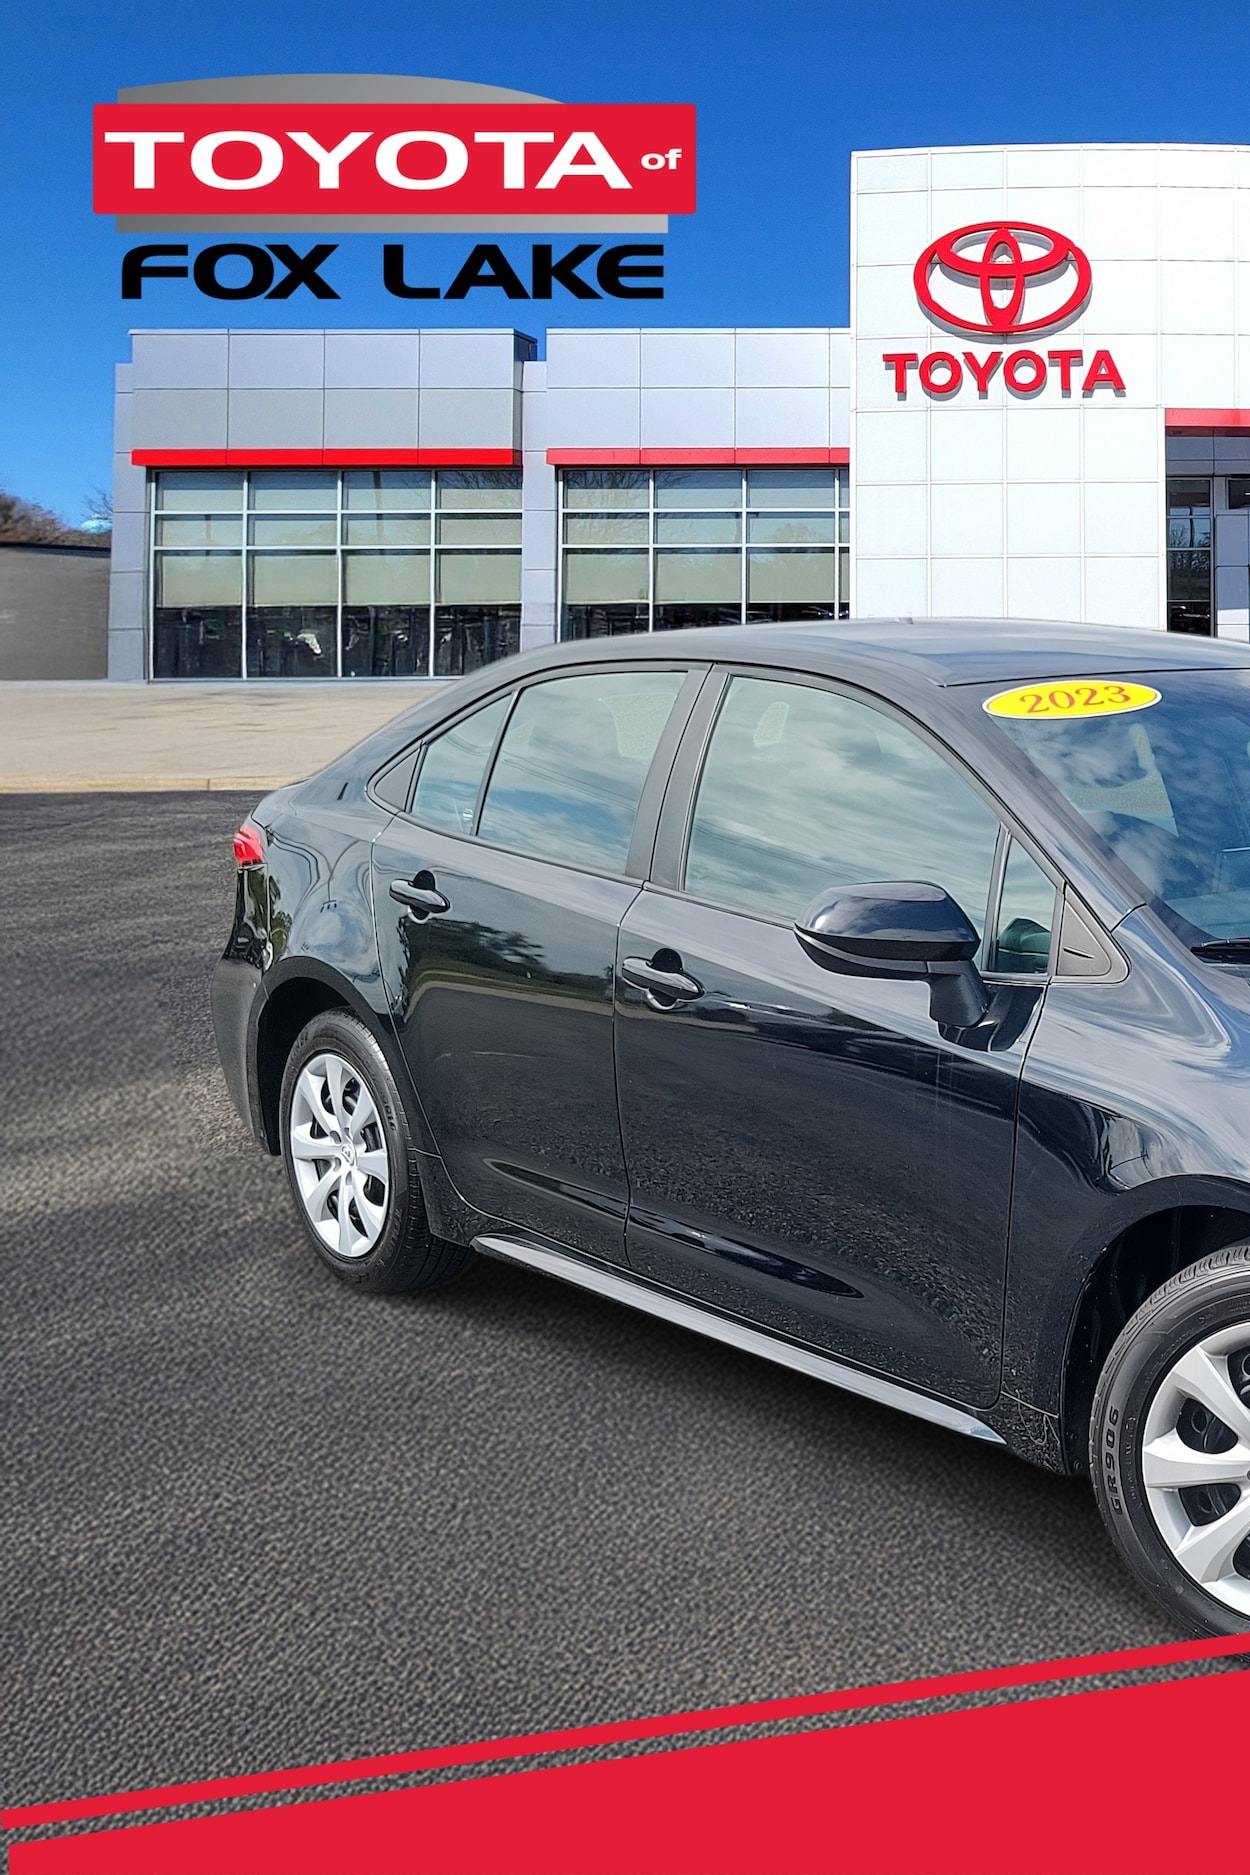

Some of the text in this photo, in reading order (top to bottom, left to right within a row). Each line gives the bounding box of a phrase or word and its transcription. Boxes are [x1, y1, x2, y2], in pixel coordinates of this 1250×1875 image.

[882, 349, 1126, 397] TOYOTA
[1020, 685, 1132, 714] 2023
[1105, 1405, 1122, 1515] GR906
